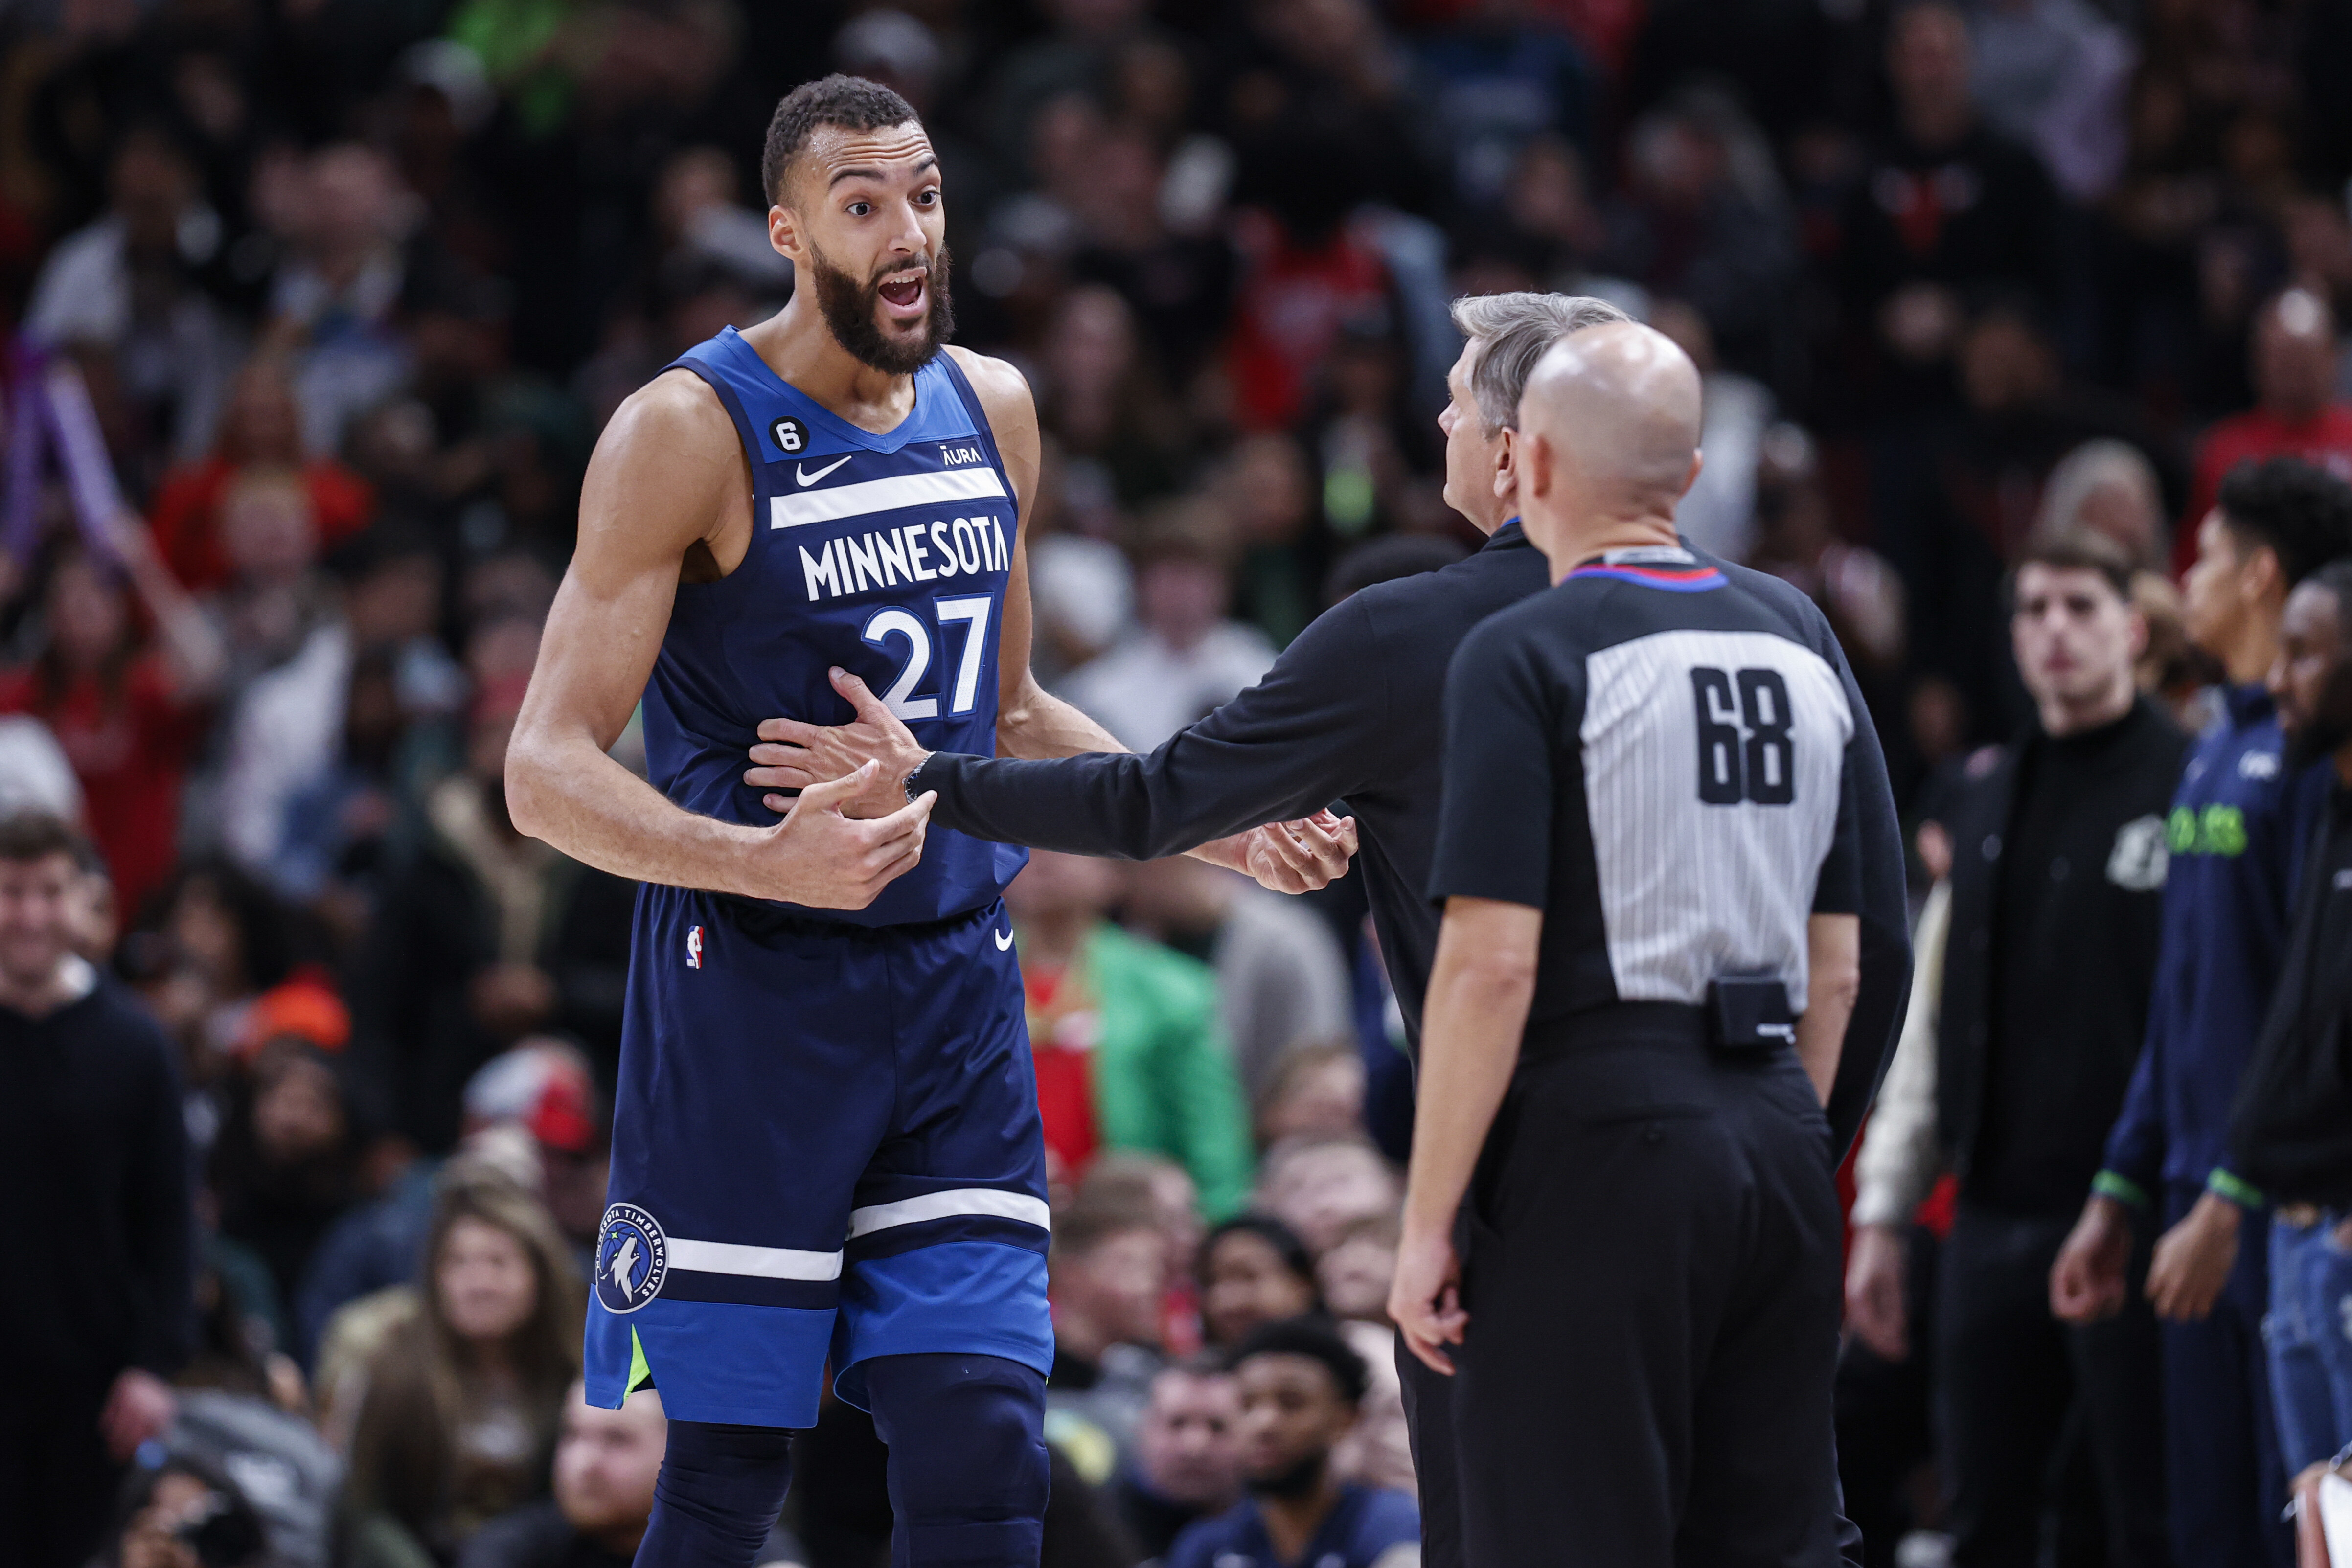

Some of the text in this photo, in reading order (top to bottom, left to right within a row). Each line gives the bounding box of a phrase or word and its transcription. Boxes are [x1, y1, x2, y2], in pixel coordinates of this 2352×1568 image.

[776, 422, 801, 451] 6
[799, 515, 1009, 602] MINNESOTA
[861, 591, 994, 721] 27
[1690, 667, 1793, 804] 68
[624, 1209, 663, 1297] TIMBERWOLVES
